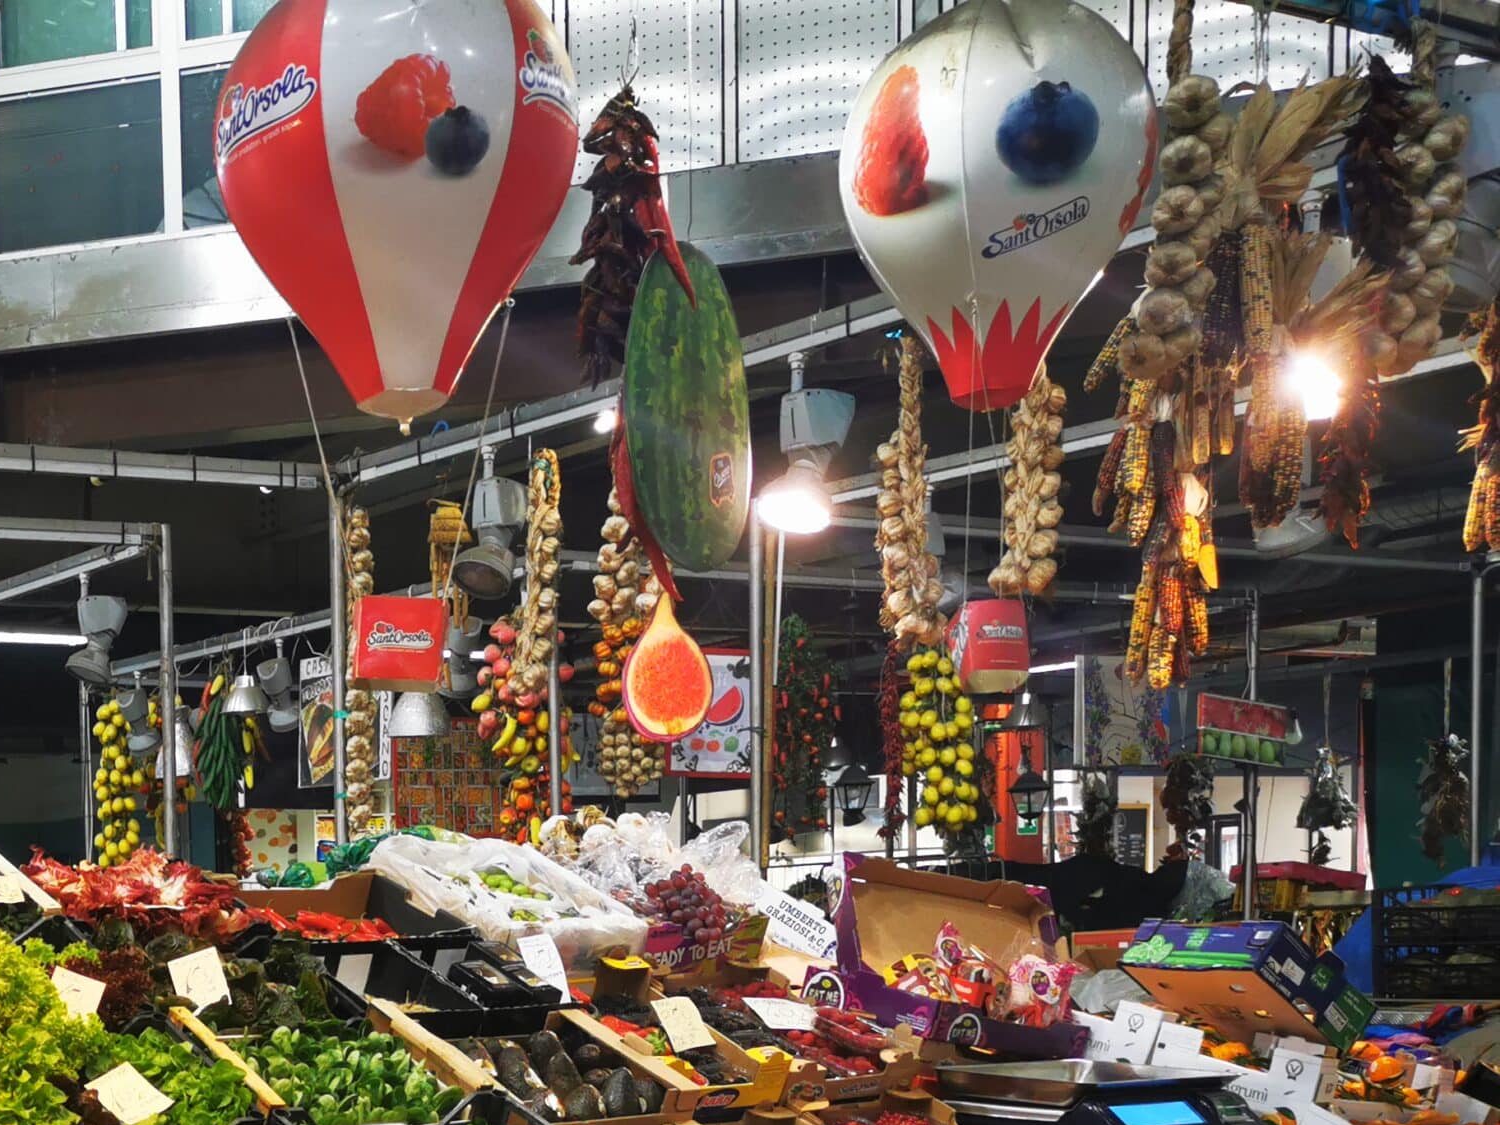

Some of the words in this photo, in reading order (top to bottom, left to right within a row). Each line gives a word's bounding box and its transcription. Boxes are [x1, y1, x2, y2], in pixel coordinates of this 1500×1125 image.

[766, 904, 811, 942] GRAZIOSI
[778, 900, 827, 935] UMBERTO
[708, 936, 735, 957] EAT
